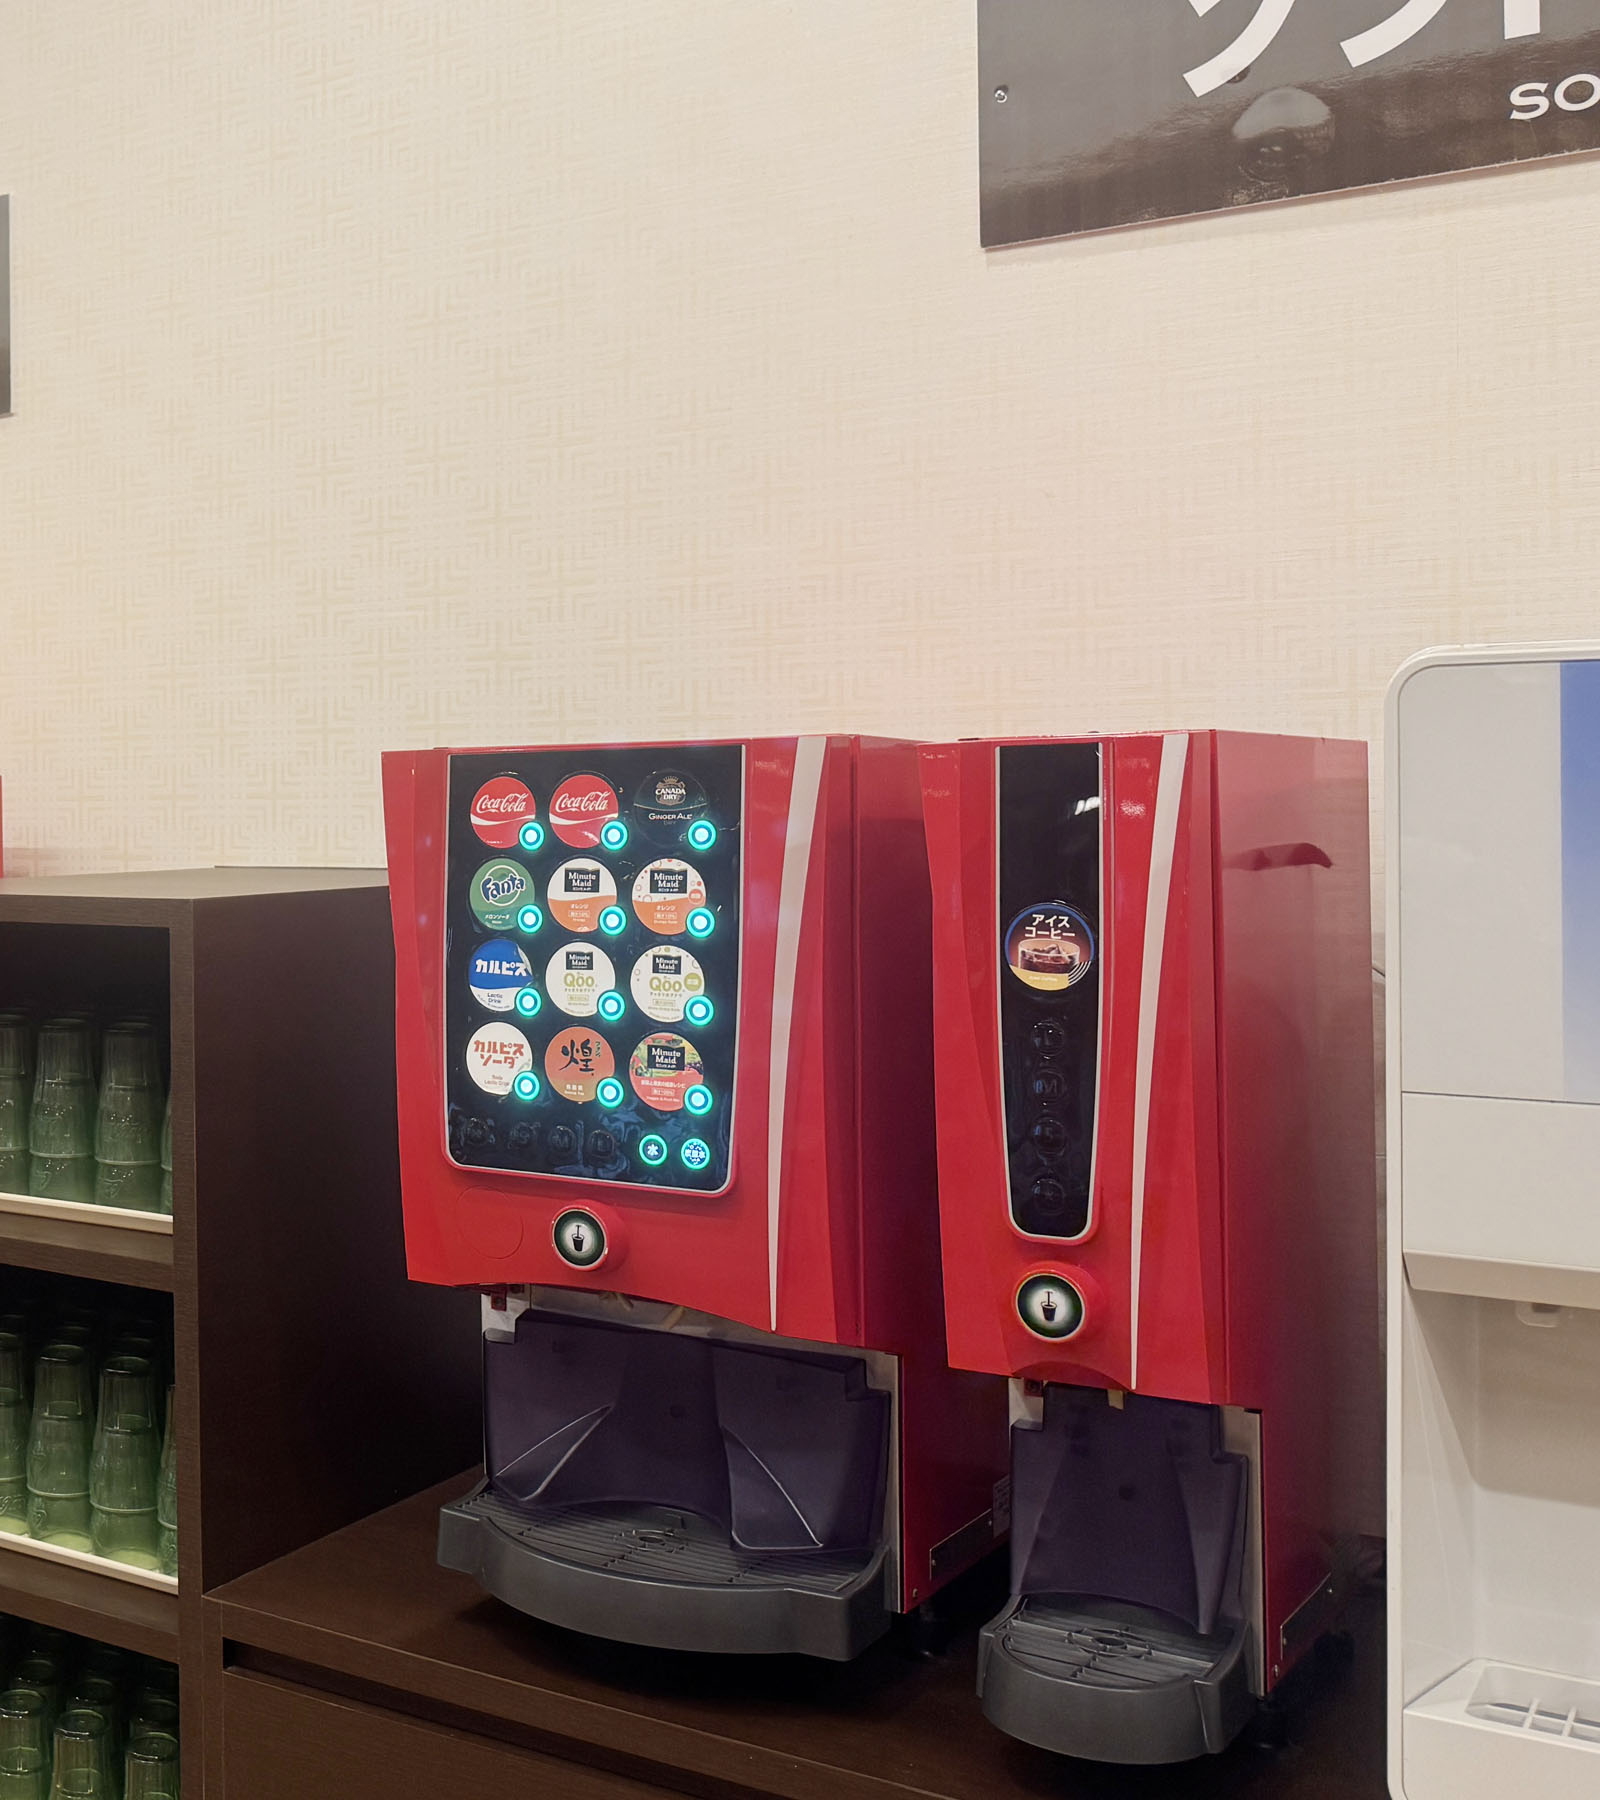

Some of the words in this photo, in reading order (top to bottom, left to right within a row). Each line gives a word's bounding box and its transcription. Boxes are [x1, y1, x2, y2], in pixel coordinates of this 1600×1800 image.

[655, 788, 687, 796] CANADA
[568, 872, 597, 880] Minute
[654, 873, 684, 881] Minute
[481, 873, 526, 903] Fanta
[657, 880, 679, 888] Maid
[1032, 914, 1070, 928] アイス
[1024, 926, 1076, 939] コーヒー
[656, 957, 679, 965] Minute
[475, 959, 527, 977] カルピス
[474, 1040, 525, 1056] カルピス
[651, 1047, 681, 1057] Minute
[480, 1053, 519, 1069] ソーダ
[655, 1056, 677, 1064] Maid
[647, 1144, 659, 1156] 水
